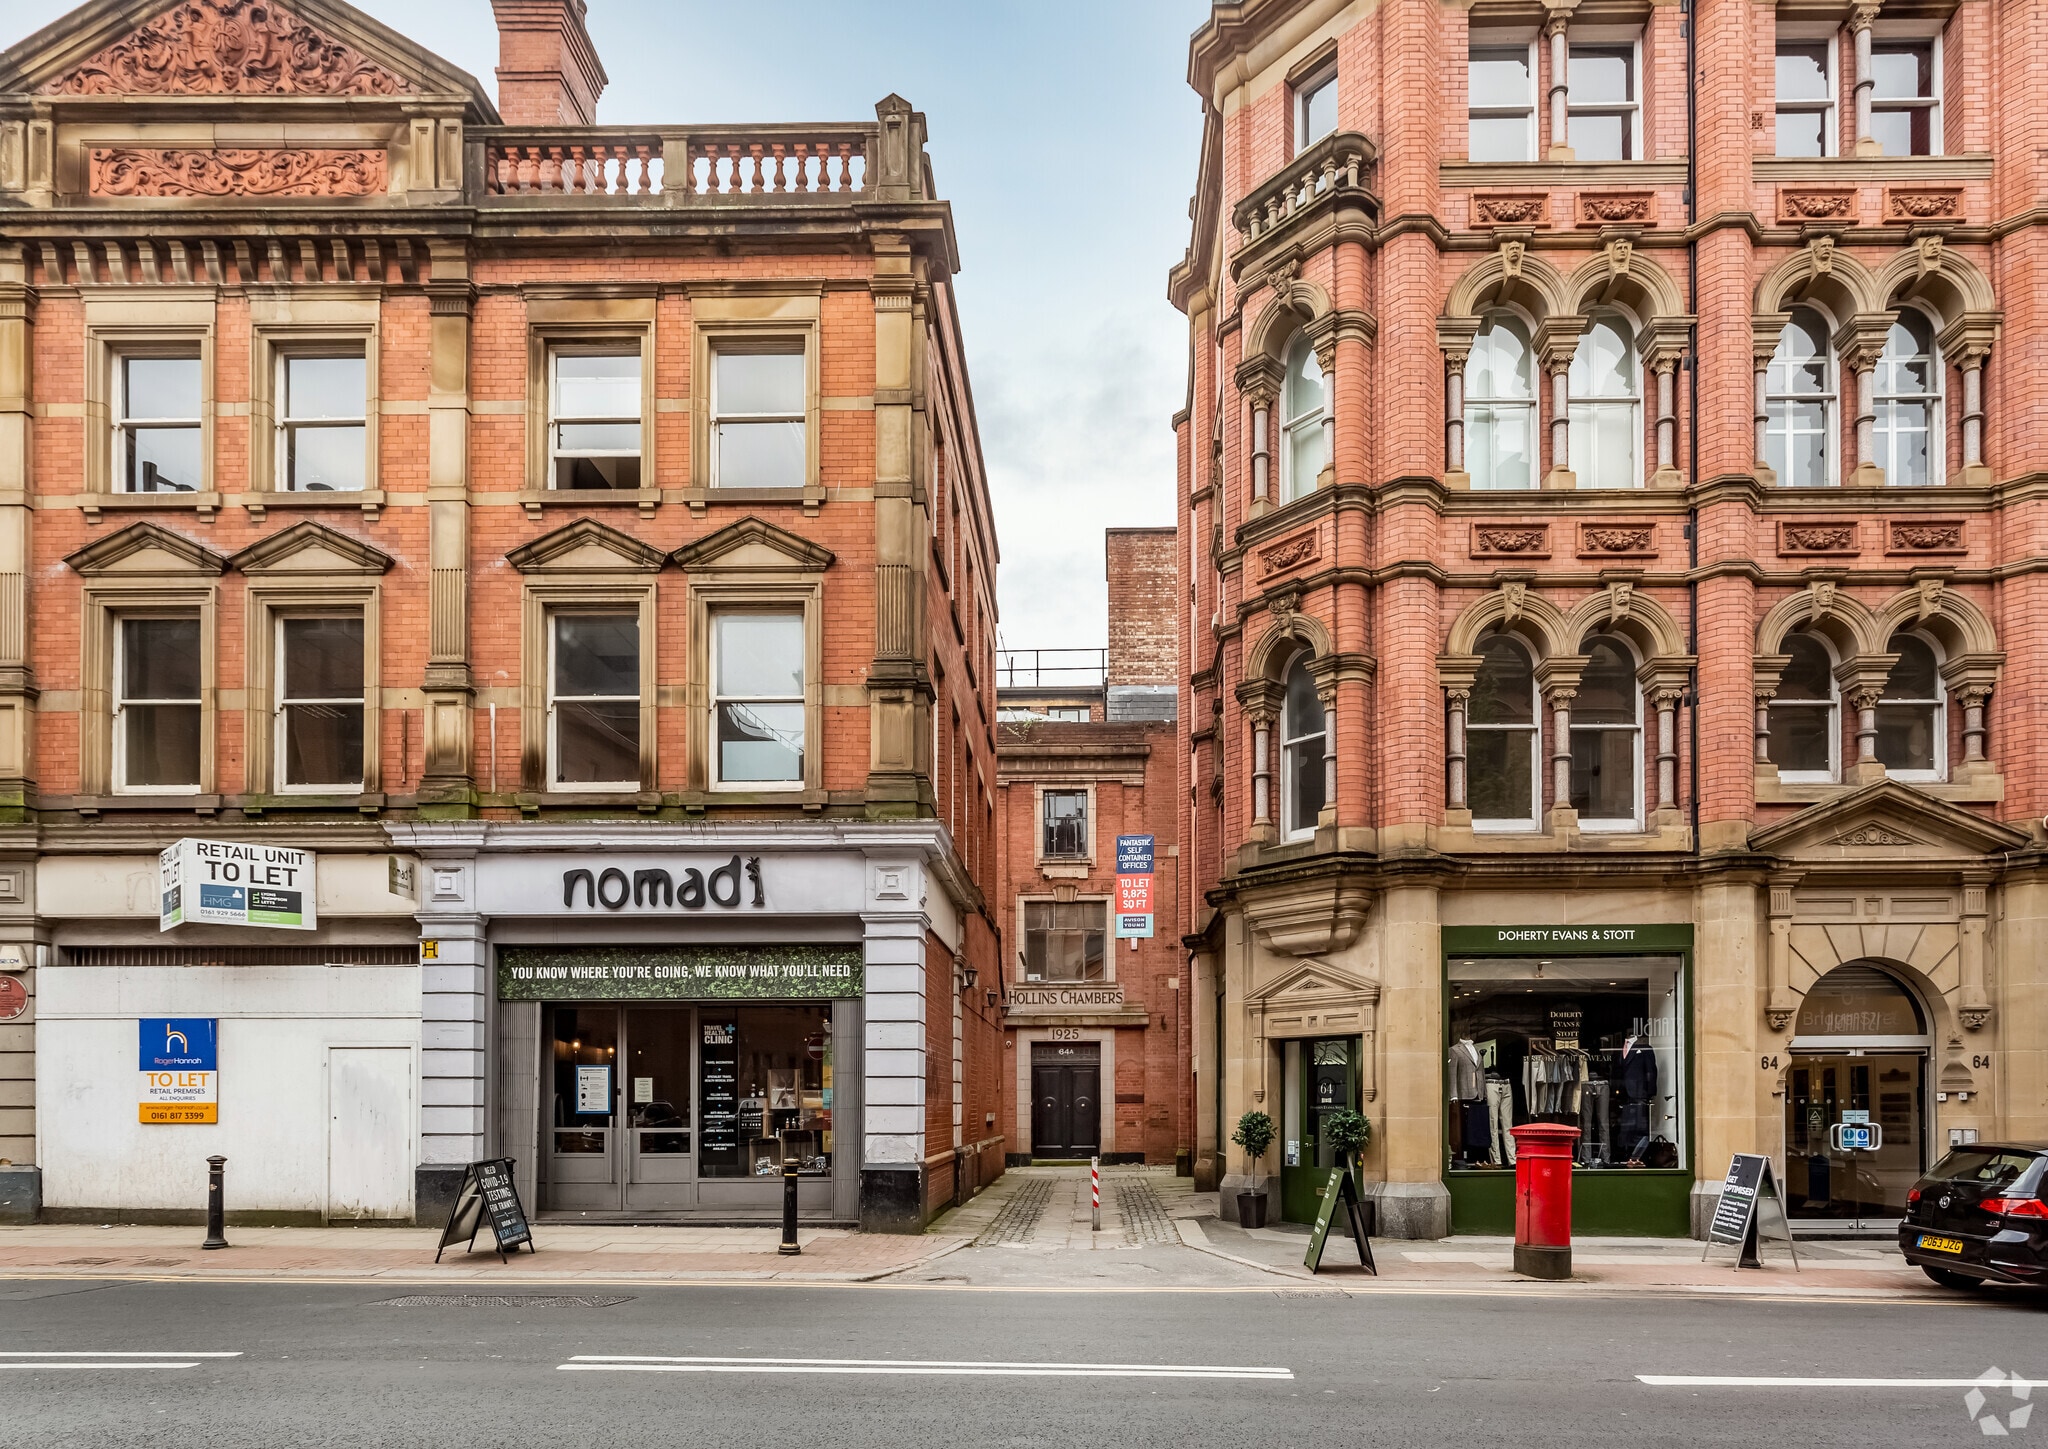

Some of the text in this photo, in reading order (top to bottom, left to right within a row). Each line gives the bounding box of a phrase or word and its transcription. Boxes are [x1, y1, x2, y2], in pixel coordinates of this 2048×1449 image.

[196, 842, 305, 865] RETAIL UNIT
[205, 860, 298, 886] TO LET
[564, 854, 741, 908] nomad
[1120, 879, 1150, 888] TO LET
[1122, 889, 1147, 899] 9,875
[203, 897, 232, 908] HMG
[1123, 899, 1147, 909] SQ FT
[1499, 930, 1635, 941] DOHERTY EVANS & STOTT
[511, 964, 850, 980] YOU KNOW WHERE YOU'RE GOING, WE KNOW WHAT YOU'LL NEED
[1008, 990, 1123, 1004] HOLLINS CHAMBERS
[704, 1036, 733, 1044] CLINIC
[1052, 1029, 1079, 1040] 1925
[1761, 1056, 1778, 1070] 64
[1972, 1056, 1990, 1068] 64
[147, 1073, 210, 1087] TO LET
[1320, 1083, 1333, 1094] 64
[484, 1166, 496, 1174] NEED
[480, 1174, 509, 1189] COVID-19
[1727, 1175, 1739, 1183] GET
[486, 1187, 512, 1202] TESTING
[1724, 1184, 1754, 1196] OPTIMISED
[489, 1203, 498, 1213] FOR
[1923, 1236, 1960, 1250] PO63 JZG
